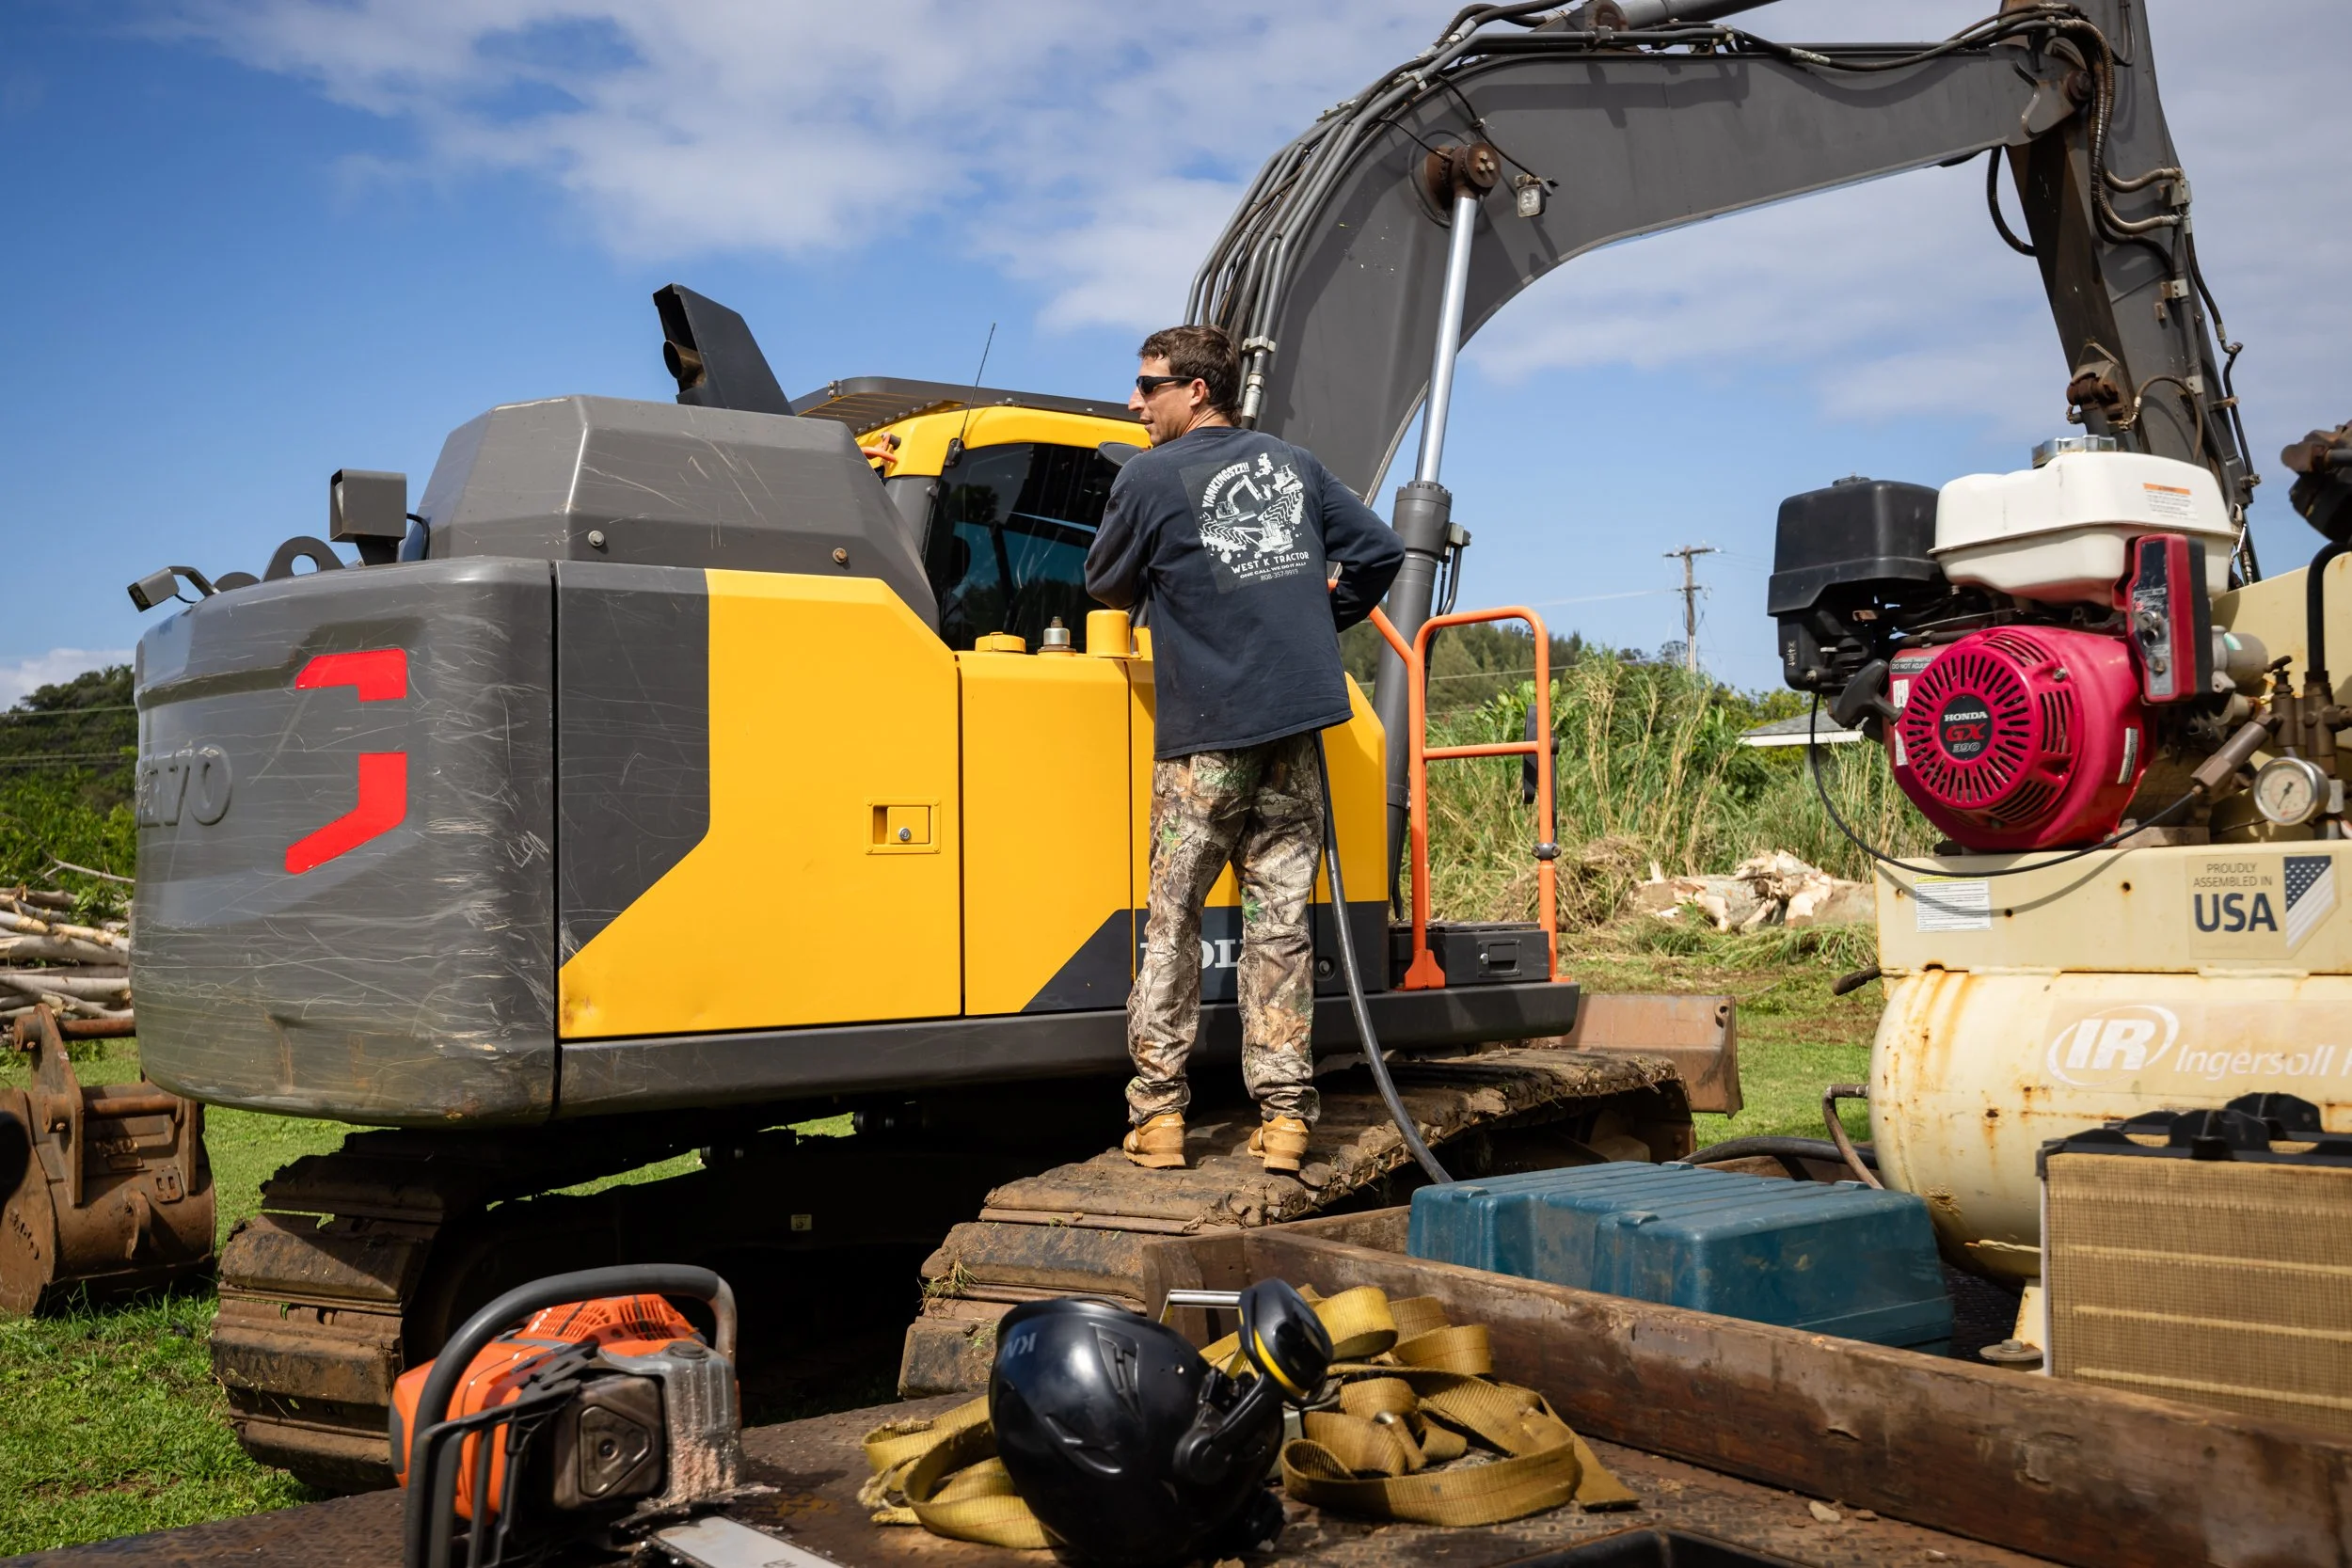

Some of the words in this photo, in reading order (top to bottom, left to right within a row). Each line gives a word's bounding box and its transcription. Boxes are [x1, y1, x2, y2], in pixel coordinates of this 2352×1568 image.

[1231, 560, 1259, 574] WEST
[1263, 558, 1270, 566] K
[1273, 551, 1310, 564] TRACTOR
[1944, 711, 1989, 722] HONDA
[1946, 723, 1987, 742] GX
[1952, 742, 1980, 753] 390
[2206, 863, 2257, 874] PROUDLY
[2193, 877, 2258, 887] ASSEMBLED
[2260, 876, 2273, 886] IN
[2194, 893, 2278, 932] USA
[2065, 1019, 2156, 1070] IR
[2173, 1044, 2336, 1081] Ingersoll
